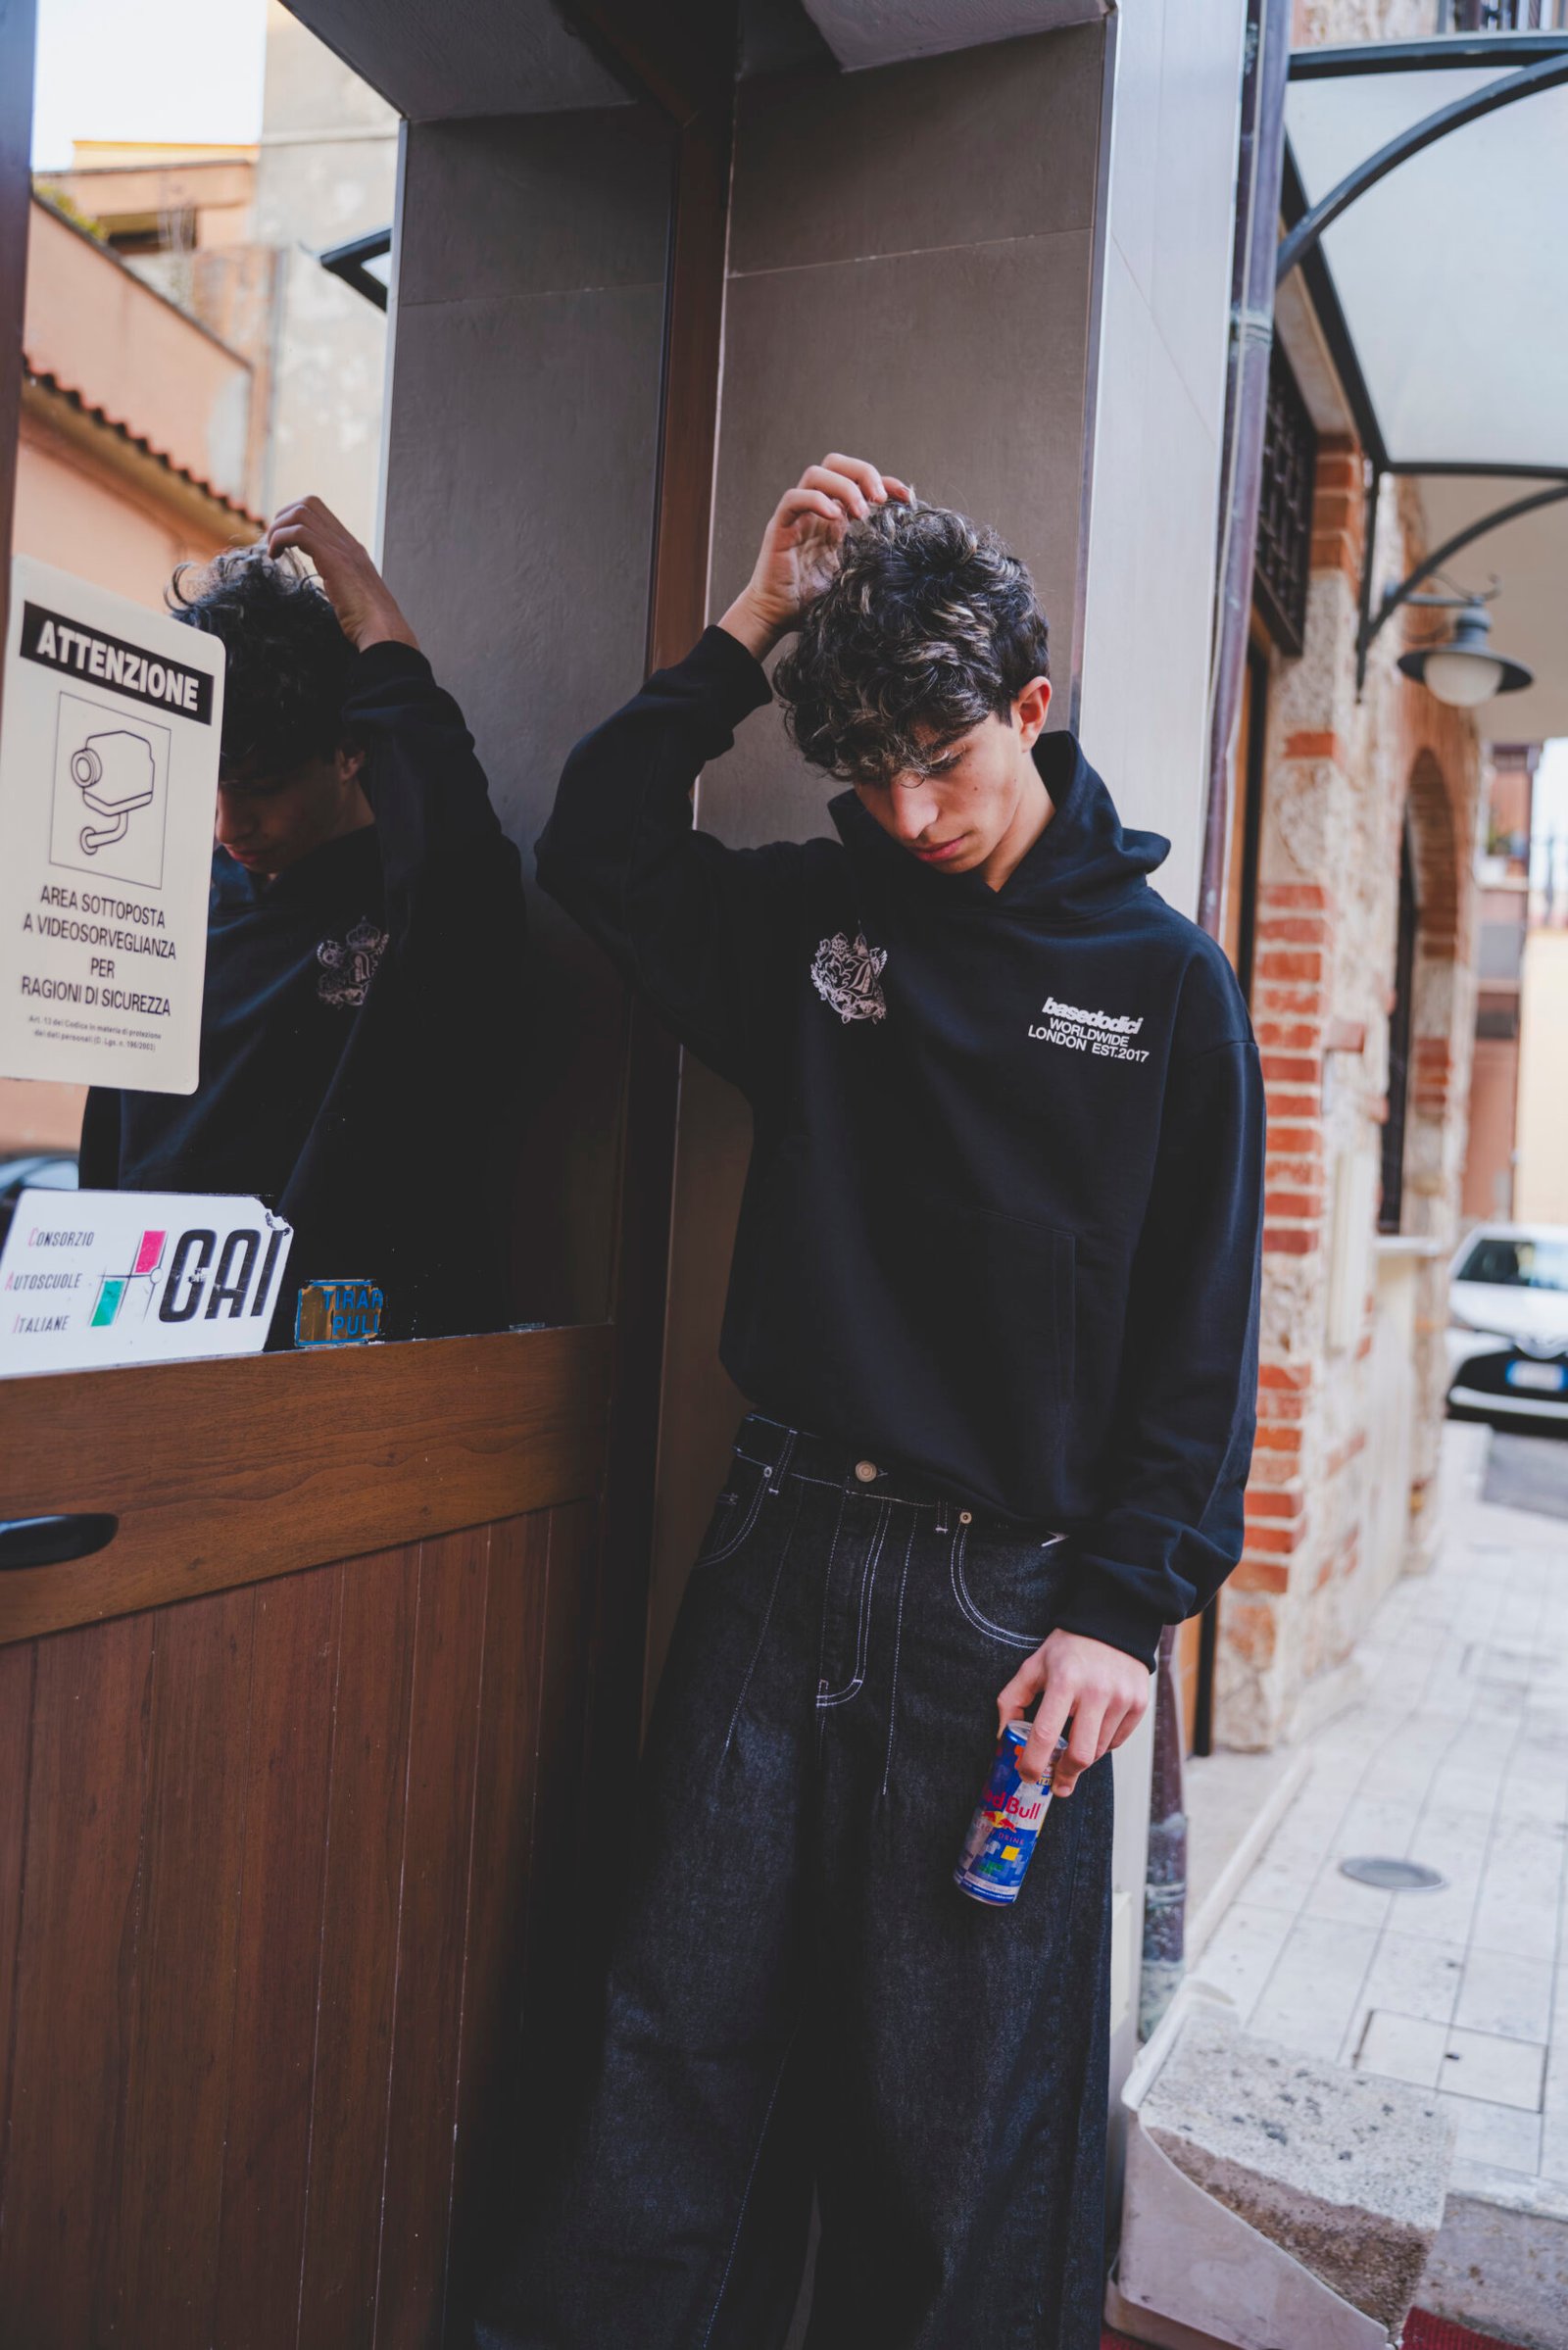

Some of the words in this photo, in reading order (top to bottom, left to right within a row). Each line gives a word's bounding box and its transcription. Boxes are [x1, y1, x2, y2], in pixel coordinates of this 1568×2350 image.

[36, 619, 200, 712] ATTENZIONE
[40, 885, 78, 910] AREA
[81, 893, 166, 929] SOTTOPOSTA
[24, 912, 34, 932] A
[37, 914, 176, 959] VIDEOSORVEGLIANZA
[90, 957, 116, 979] PER
[22, 976, 82, 1004] RAGIONI
[85, 986, 99, 1006] DI
[102, 989, 172, 1016] SICUREZZA
[97, 1025, 122, 1035] materia
[128, 1029, 162, 1040] protezione
[1028, 1024, 1088, 1051] LONDON
[1092, 1042, 1150, 1062] EST.2017
[1050, 1017, 1130, 1048] WORLDWIDE
[28, 1227, 95, 1248] CONSORZIO
[5, 1270, 83, 1291] AUTOSCUOLE
[159, 1228, 287, 1323] GAI
[322, 1288, 384, 1310] TIRAR
[12, 1313, 70, 1334] ITALIANE
[982, 1786, 1006, 1810] ed
[1005, 1795, 1042, 1820] Bull
